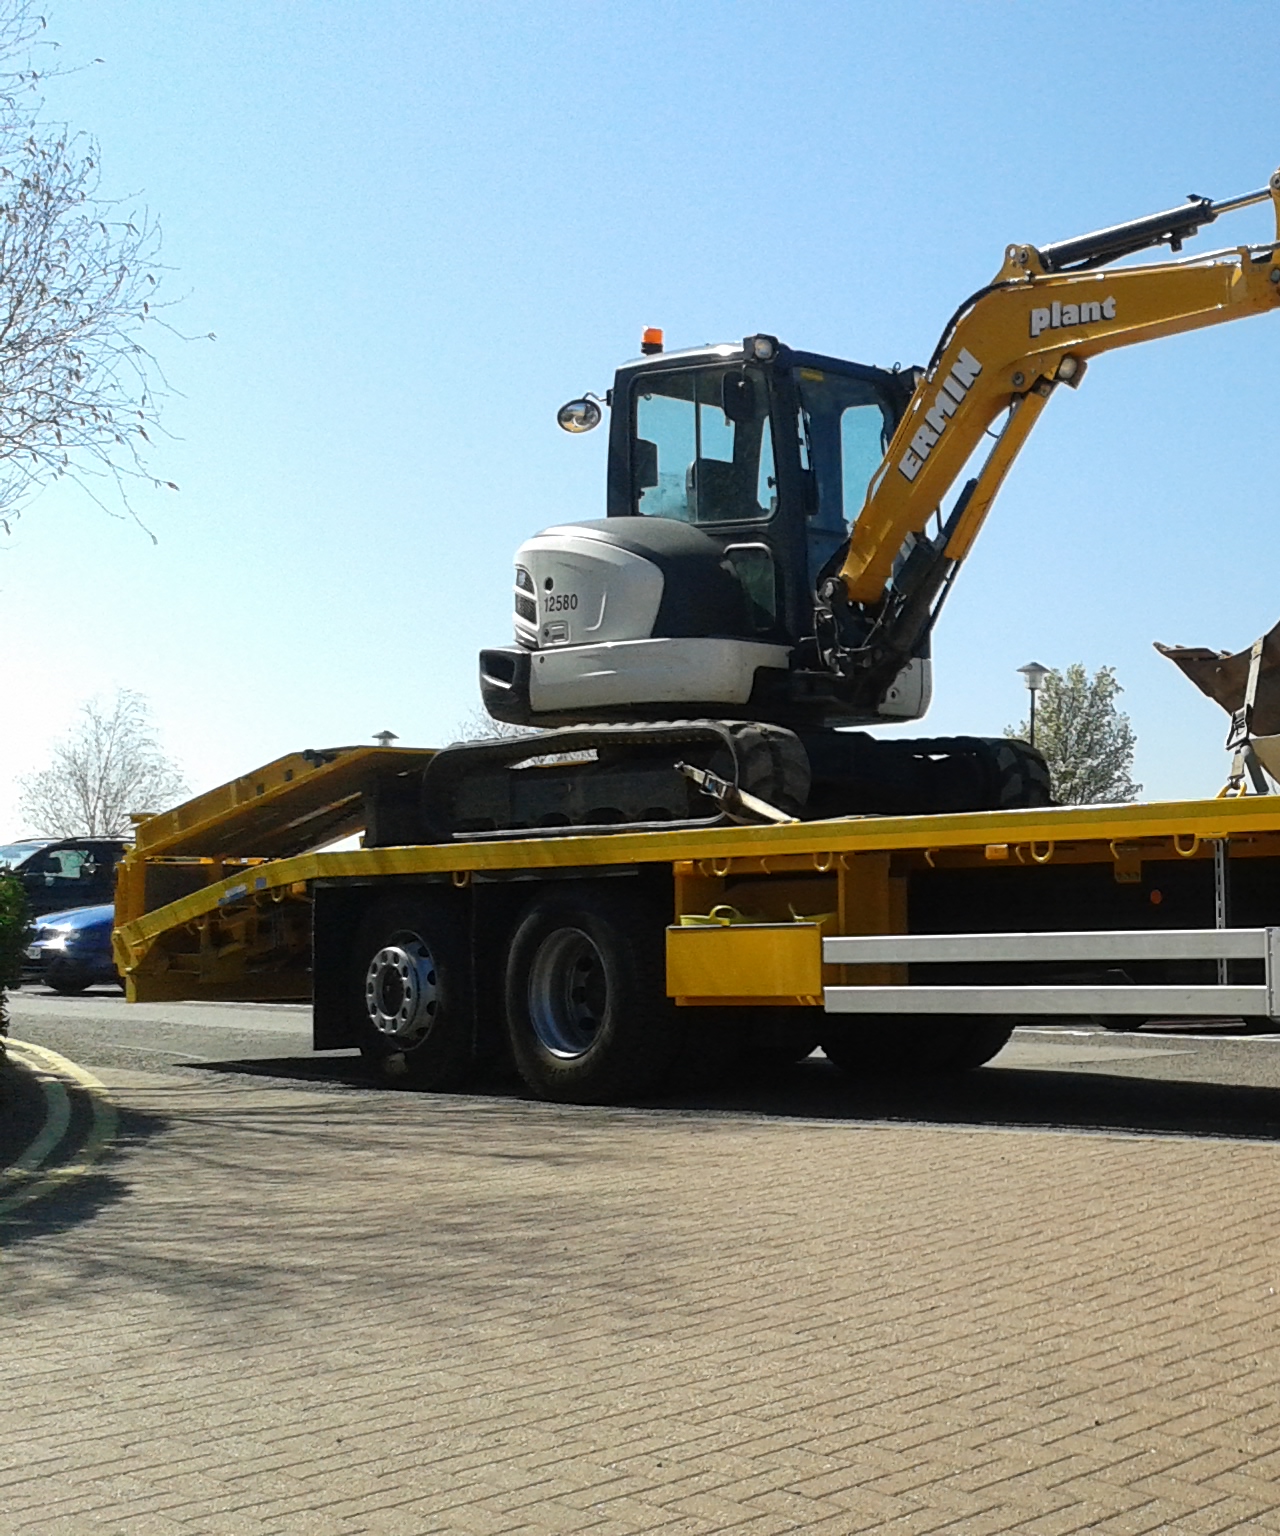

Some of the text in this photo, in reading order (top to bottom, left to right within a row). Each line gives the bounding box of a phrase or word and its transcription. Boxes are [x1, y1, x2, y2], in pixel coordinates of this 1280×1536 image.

[1030, 296, 1116, 338] plant
[898, 347, 982, 483] ERMIN
[544, 593, 578, 613] 12580
